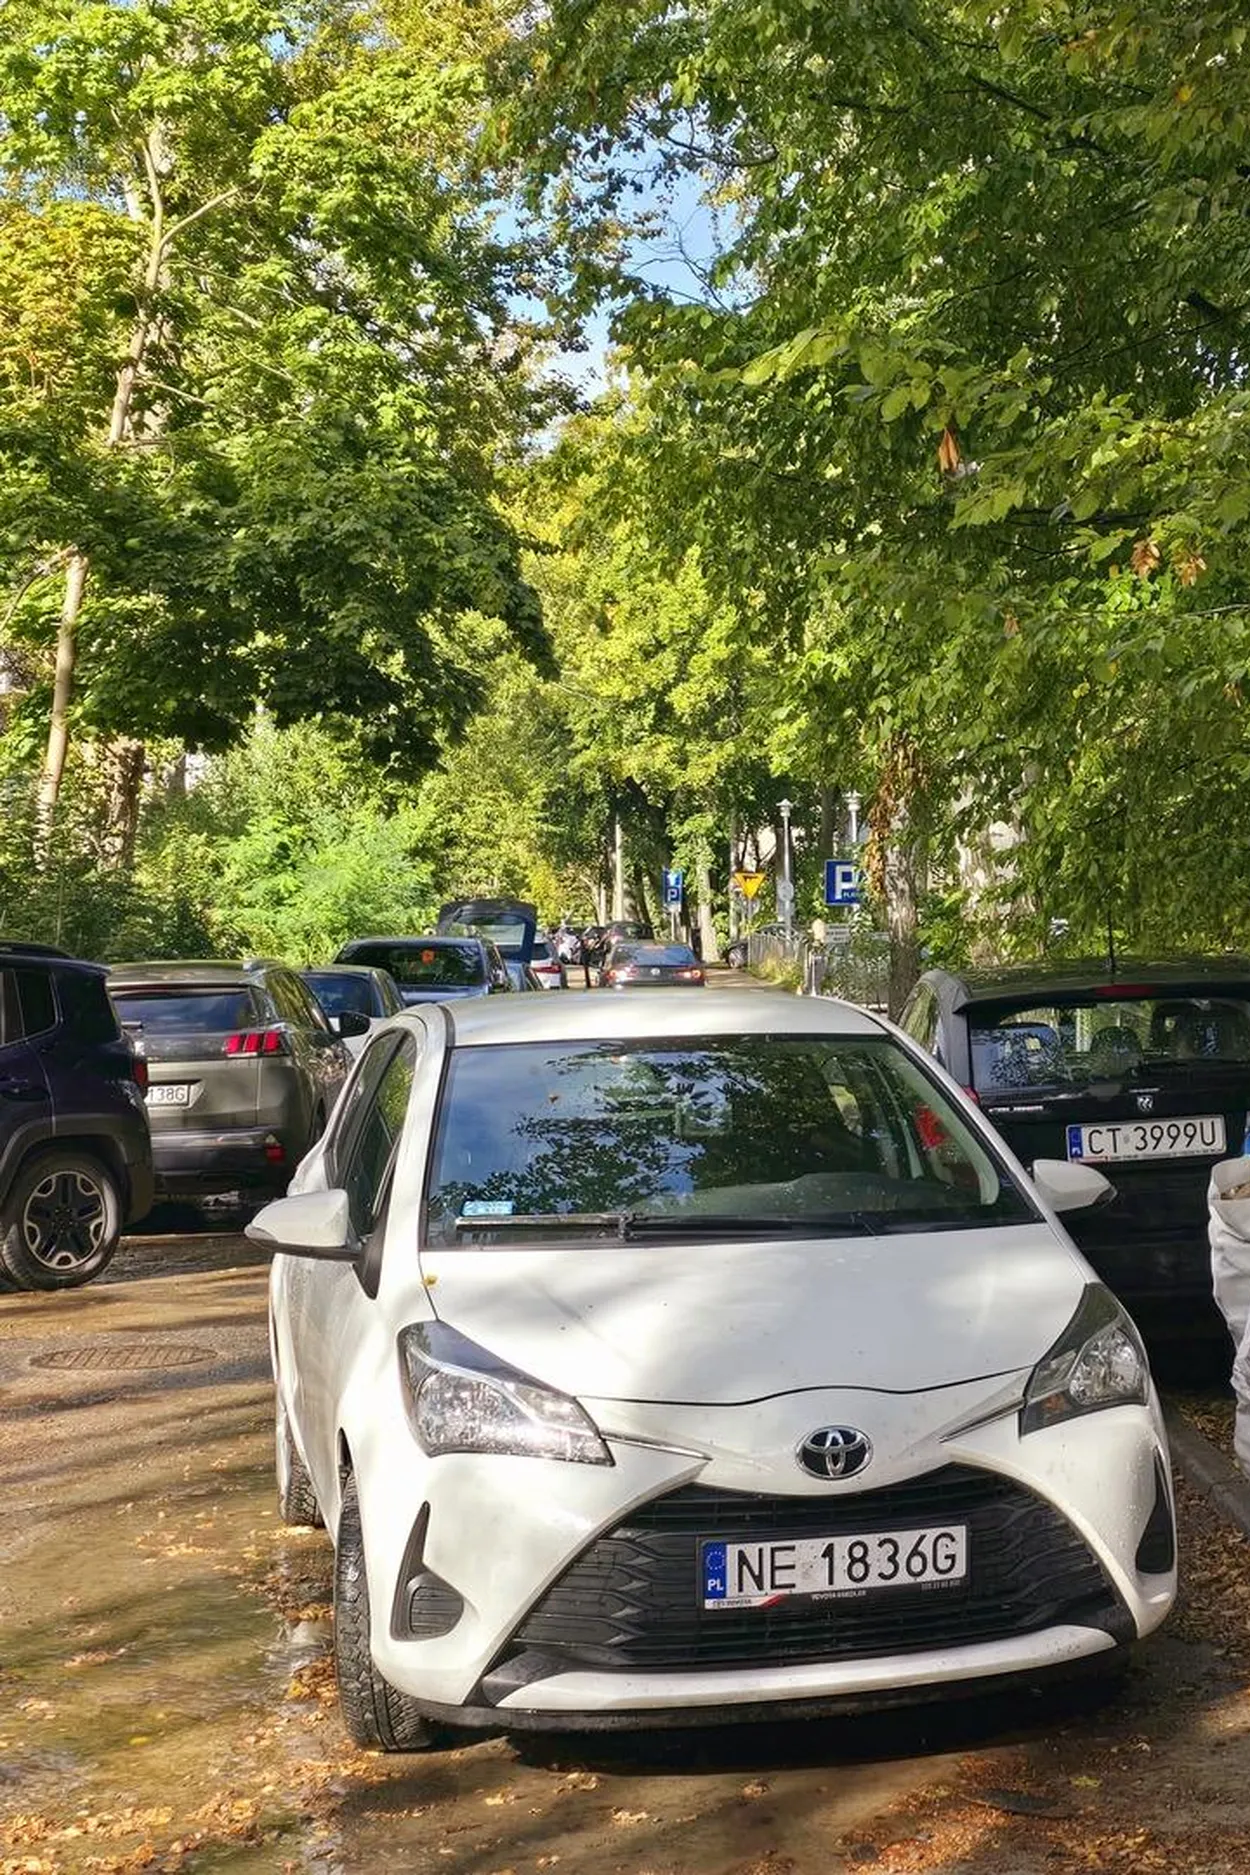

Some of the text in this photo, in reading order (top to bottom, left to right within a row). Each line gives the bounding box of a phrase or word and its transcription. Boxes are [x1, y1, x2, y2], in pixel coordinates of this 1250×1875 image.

[835, 865, 858, 900] P
[148, 1086, 186, 1102] 138G
[1088, 1120, 1216, 1155] CT 3999U
[737, 1532, 957, 1593] NE 1836G
[707, 1578, 724, 1591] PL
